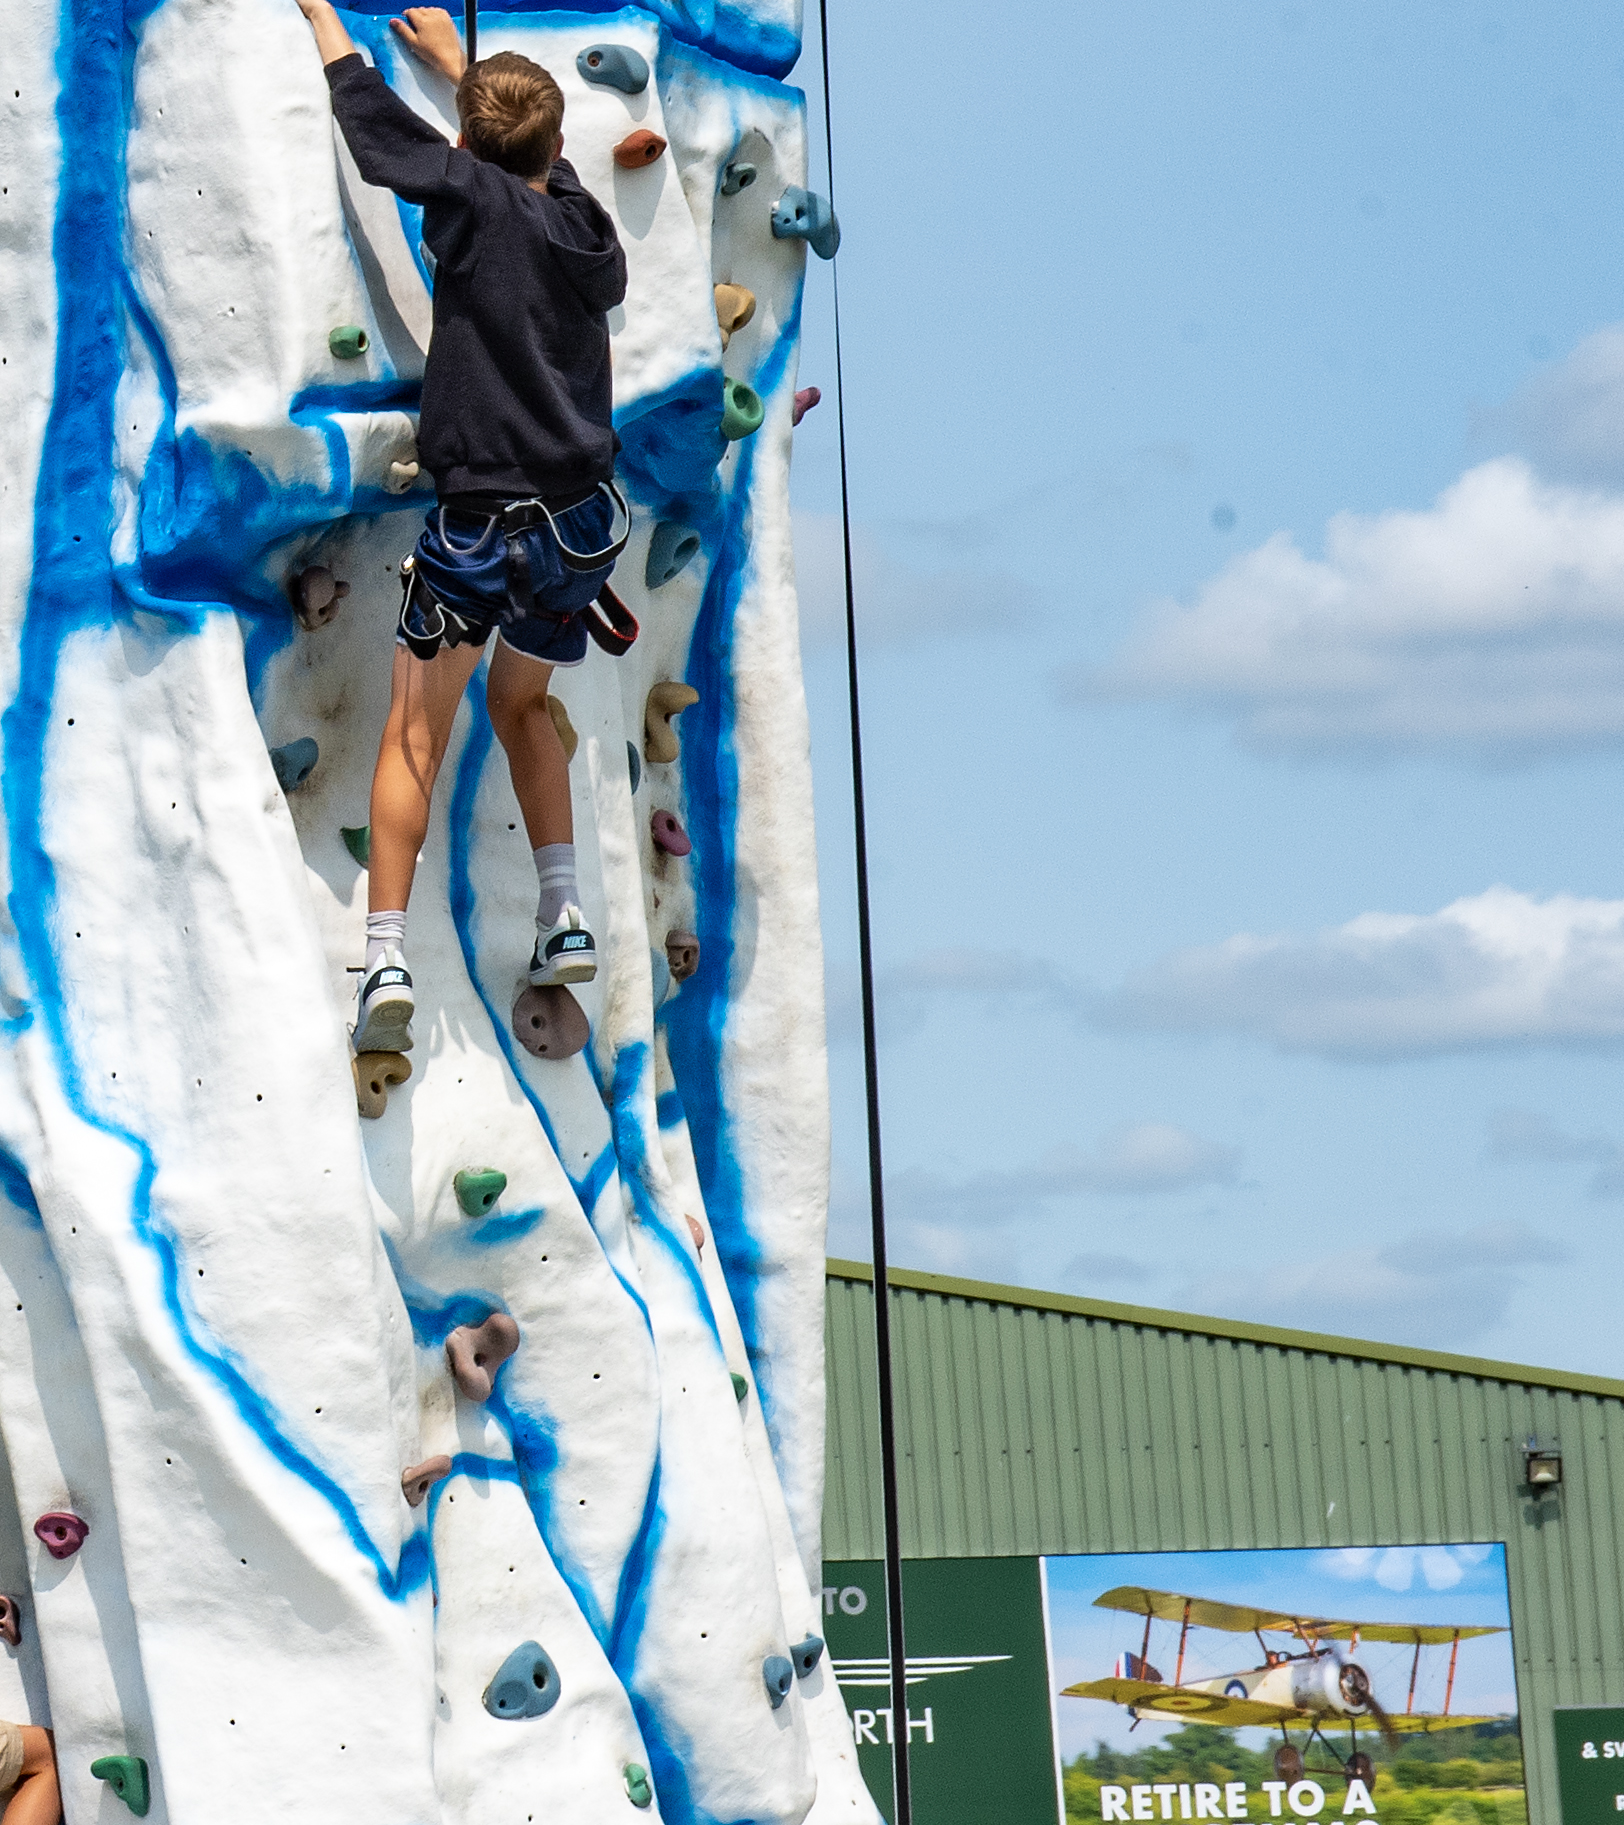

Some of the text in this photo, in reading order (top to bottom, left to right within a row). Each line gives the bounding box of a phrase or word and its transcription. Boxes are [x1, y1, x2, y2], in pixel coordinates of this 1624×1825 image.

[562, 935, 588, 950] NIKE
[378, 971, 406, 986] NIKE
[1099, 1778, 1378, 1822] RETIRE TO A
